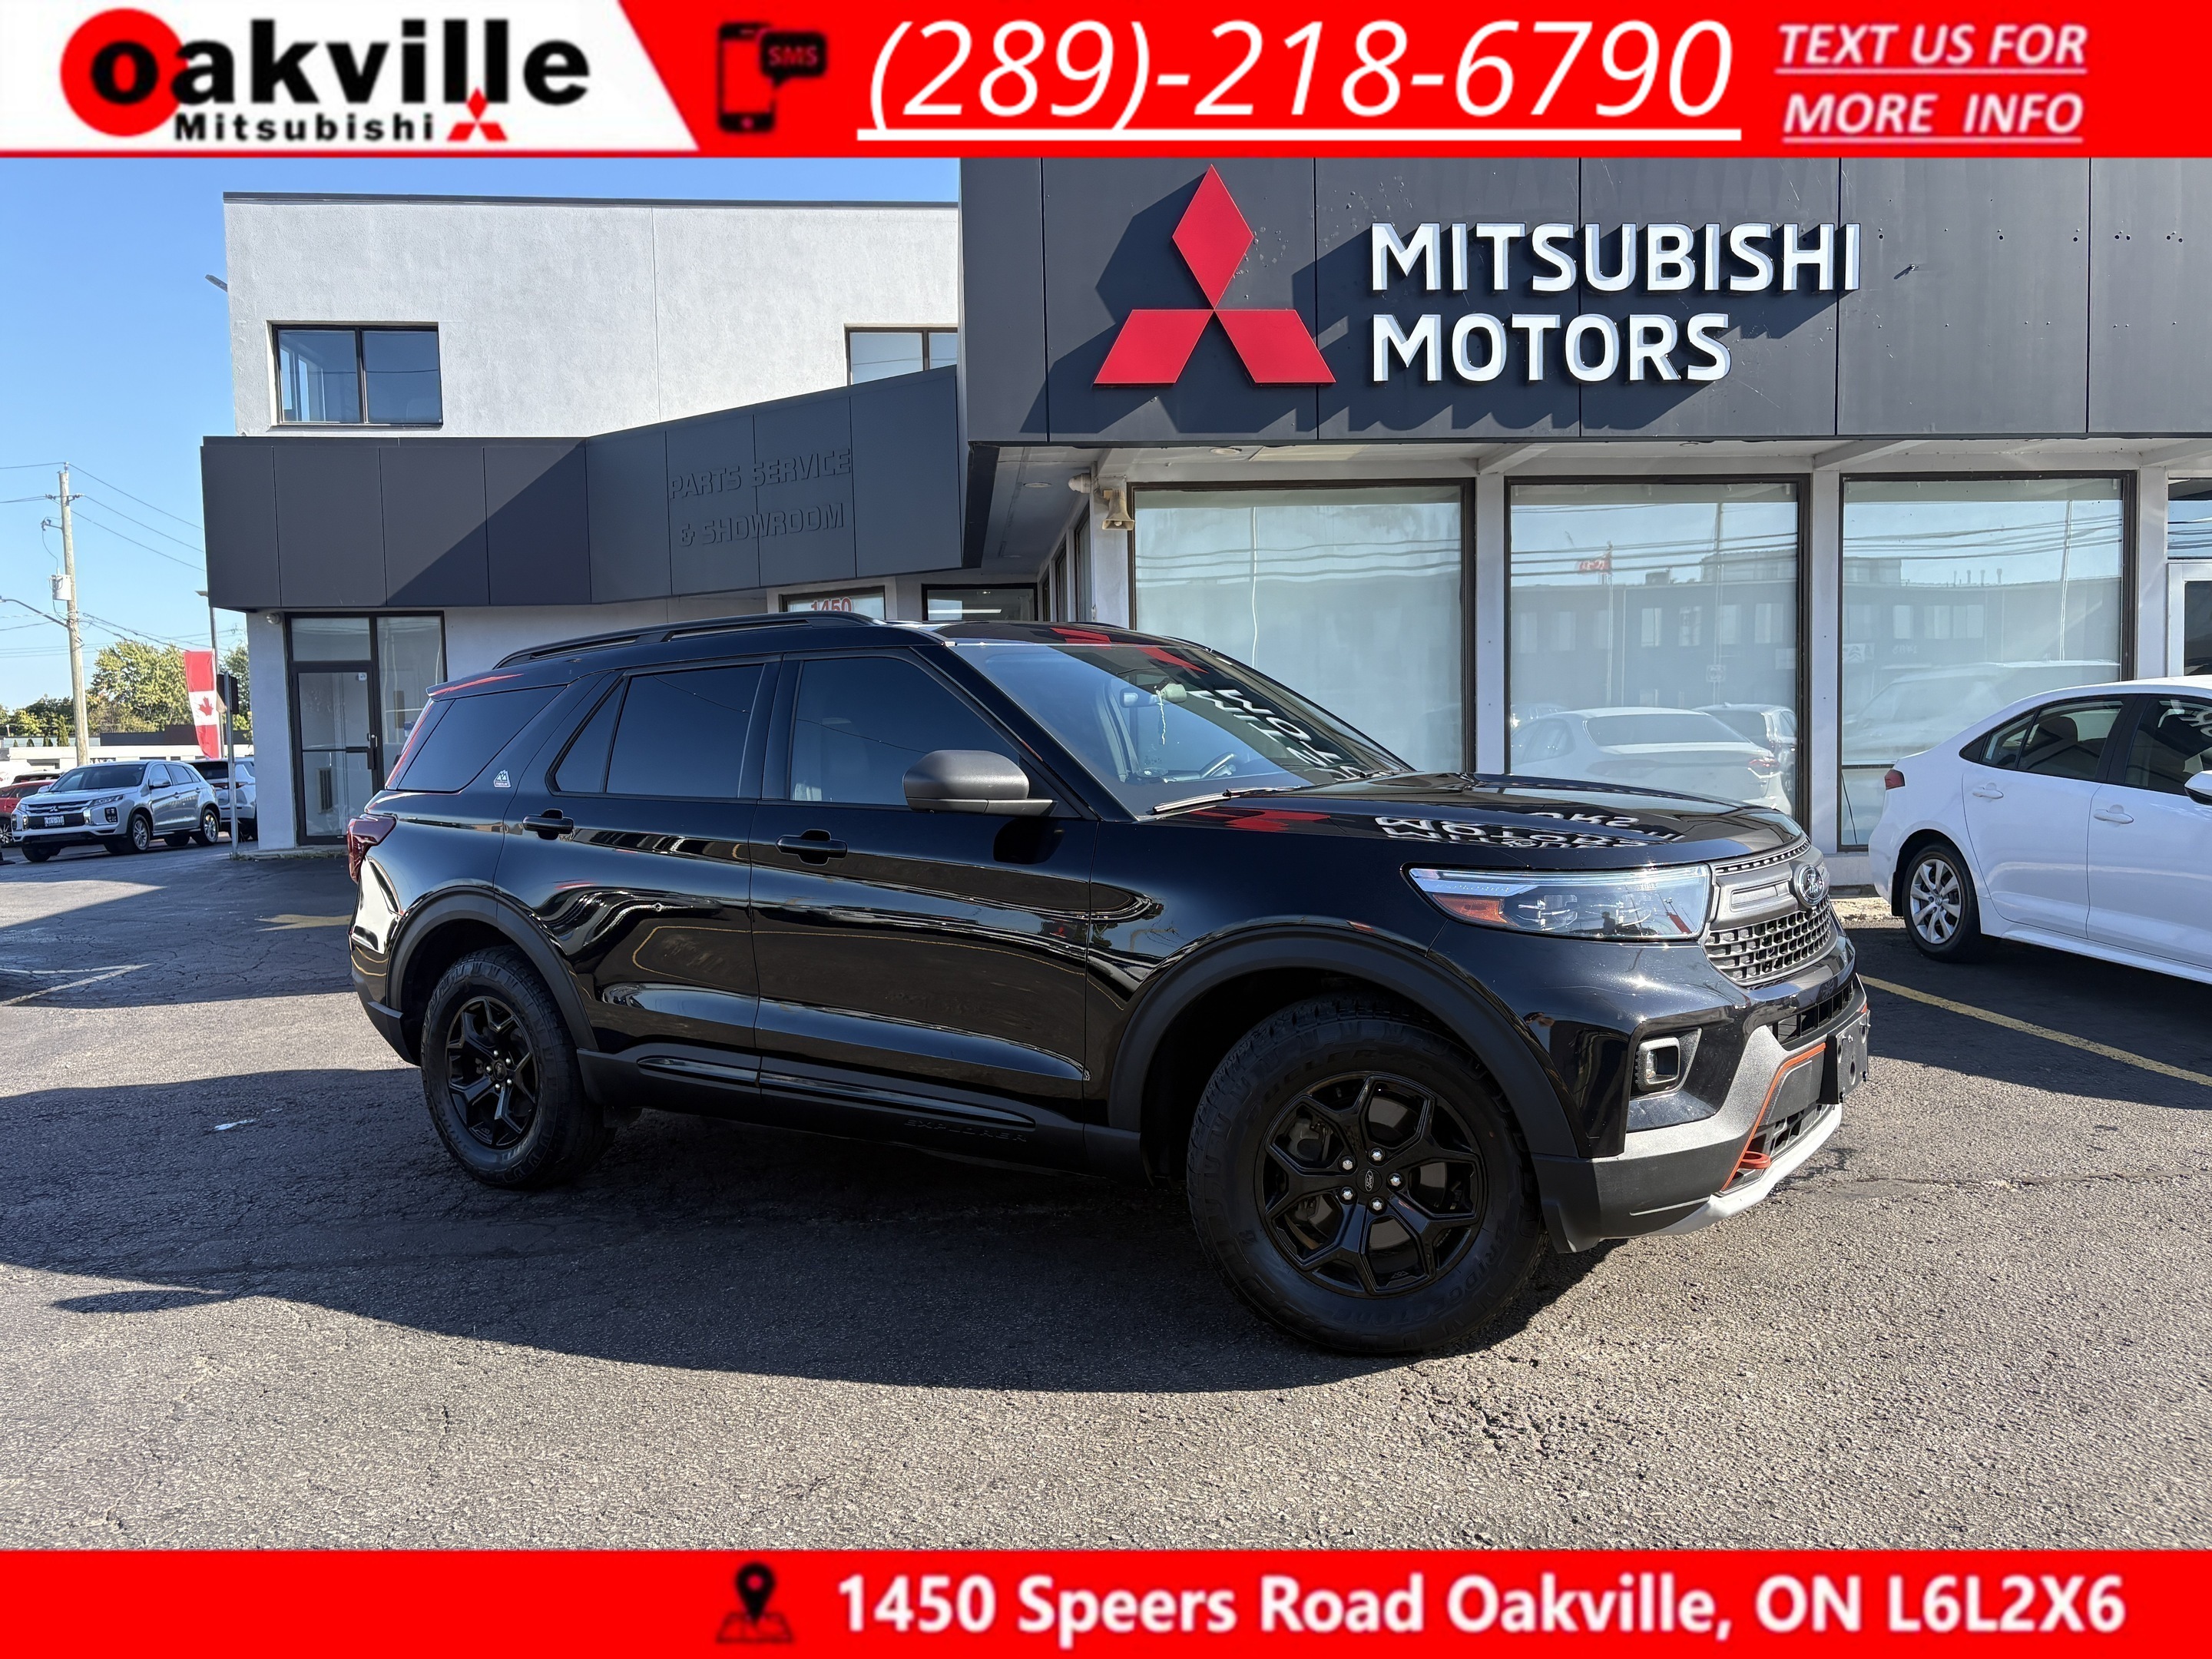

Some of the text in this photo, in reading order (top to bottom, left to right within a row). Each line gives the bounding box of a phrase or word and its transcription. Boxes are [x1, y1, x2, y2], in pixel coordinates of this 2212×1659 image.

[1371, 222, 1862, 293] MITSUBISHI
[1372, 313, 1732, 383] MOTORS
[669, 448, 852, 500] PARTS SERVICE
[702, 502, 845, 545] SHOWROOM
